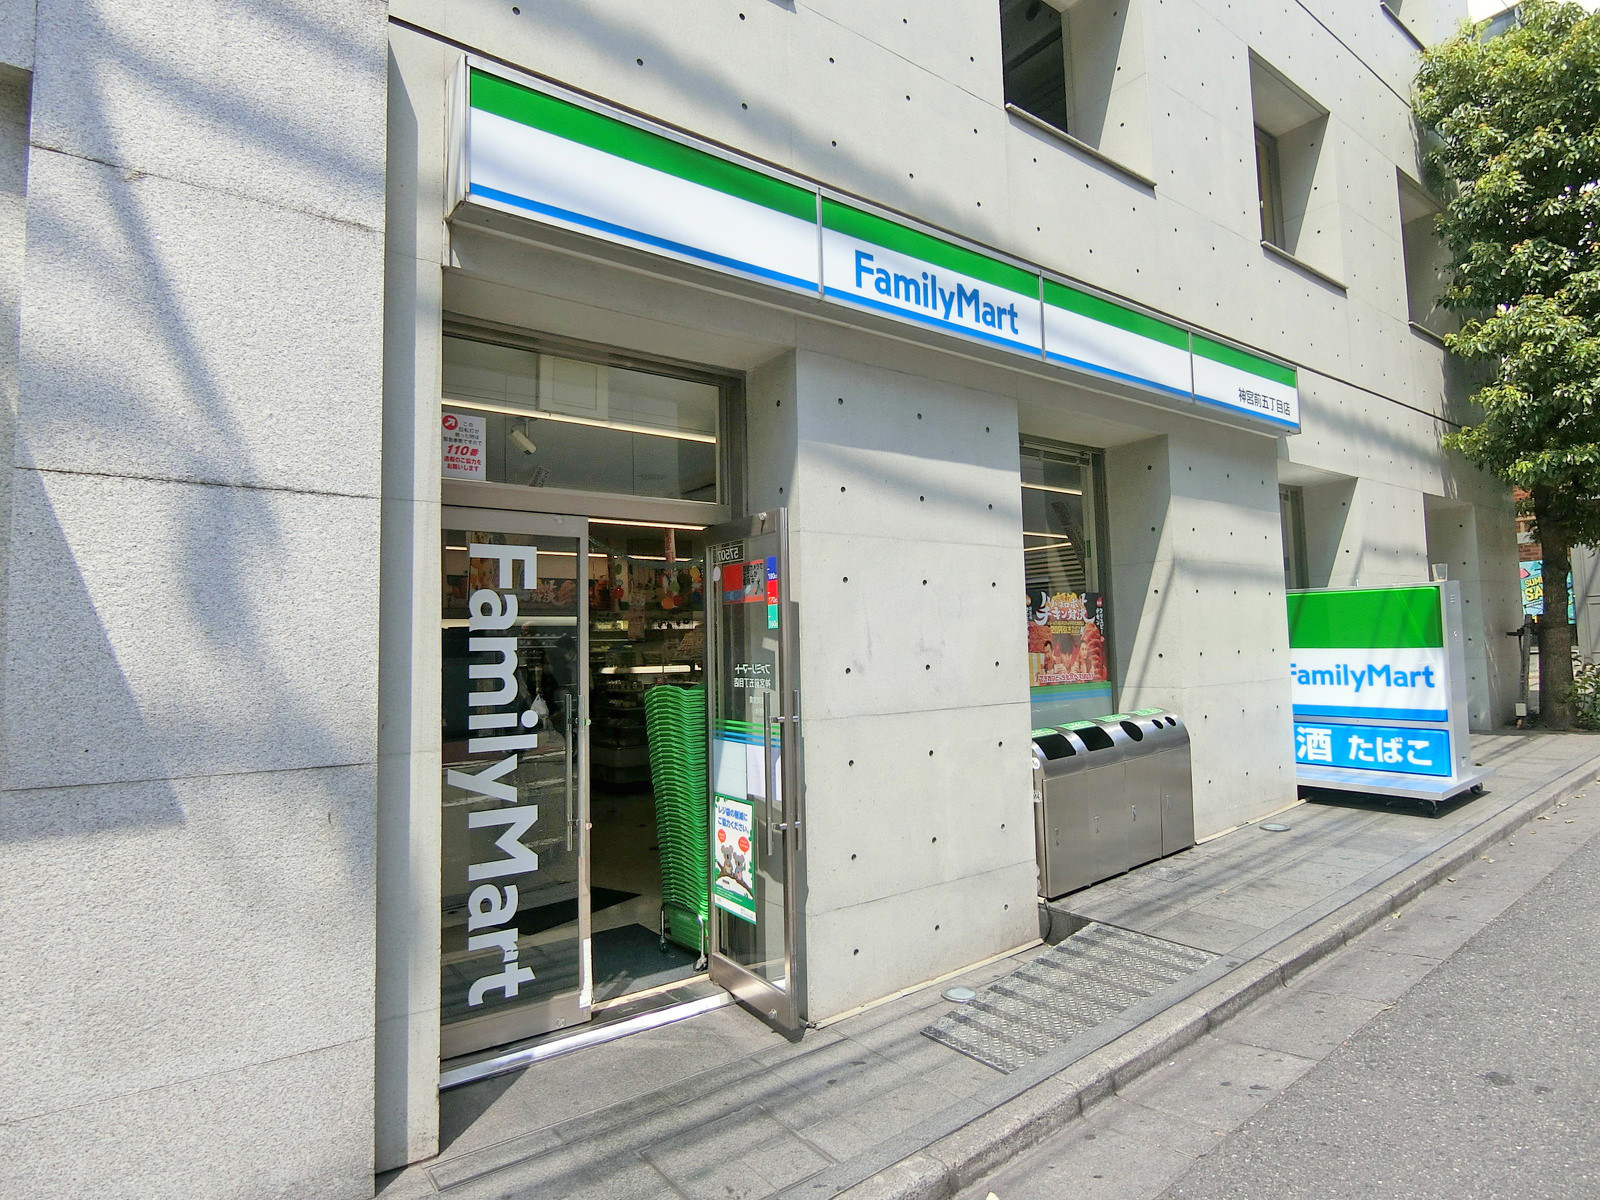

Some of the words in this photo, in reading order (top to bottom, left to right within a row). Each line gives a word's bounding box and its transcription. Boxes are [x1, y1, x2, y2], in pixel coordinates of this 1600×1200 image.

[855, 249, 1019, 335] FamilyMart
[1238, 386, 1291, 416] 神宮前五丁目店
[447, 444, 479, 457] 110番
[1296, 726, 1333, 762] 酒
[1348, 734, 1433, 766] たばこ
[447, 543, 539, 1007] FamilyMart
